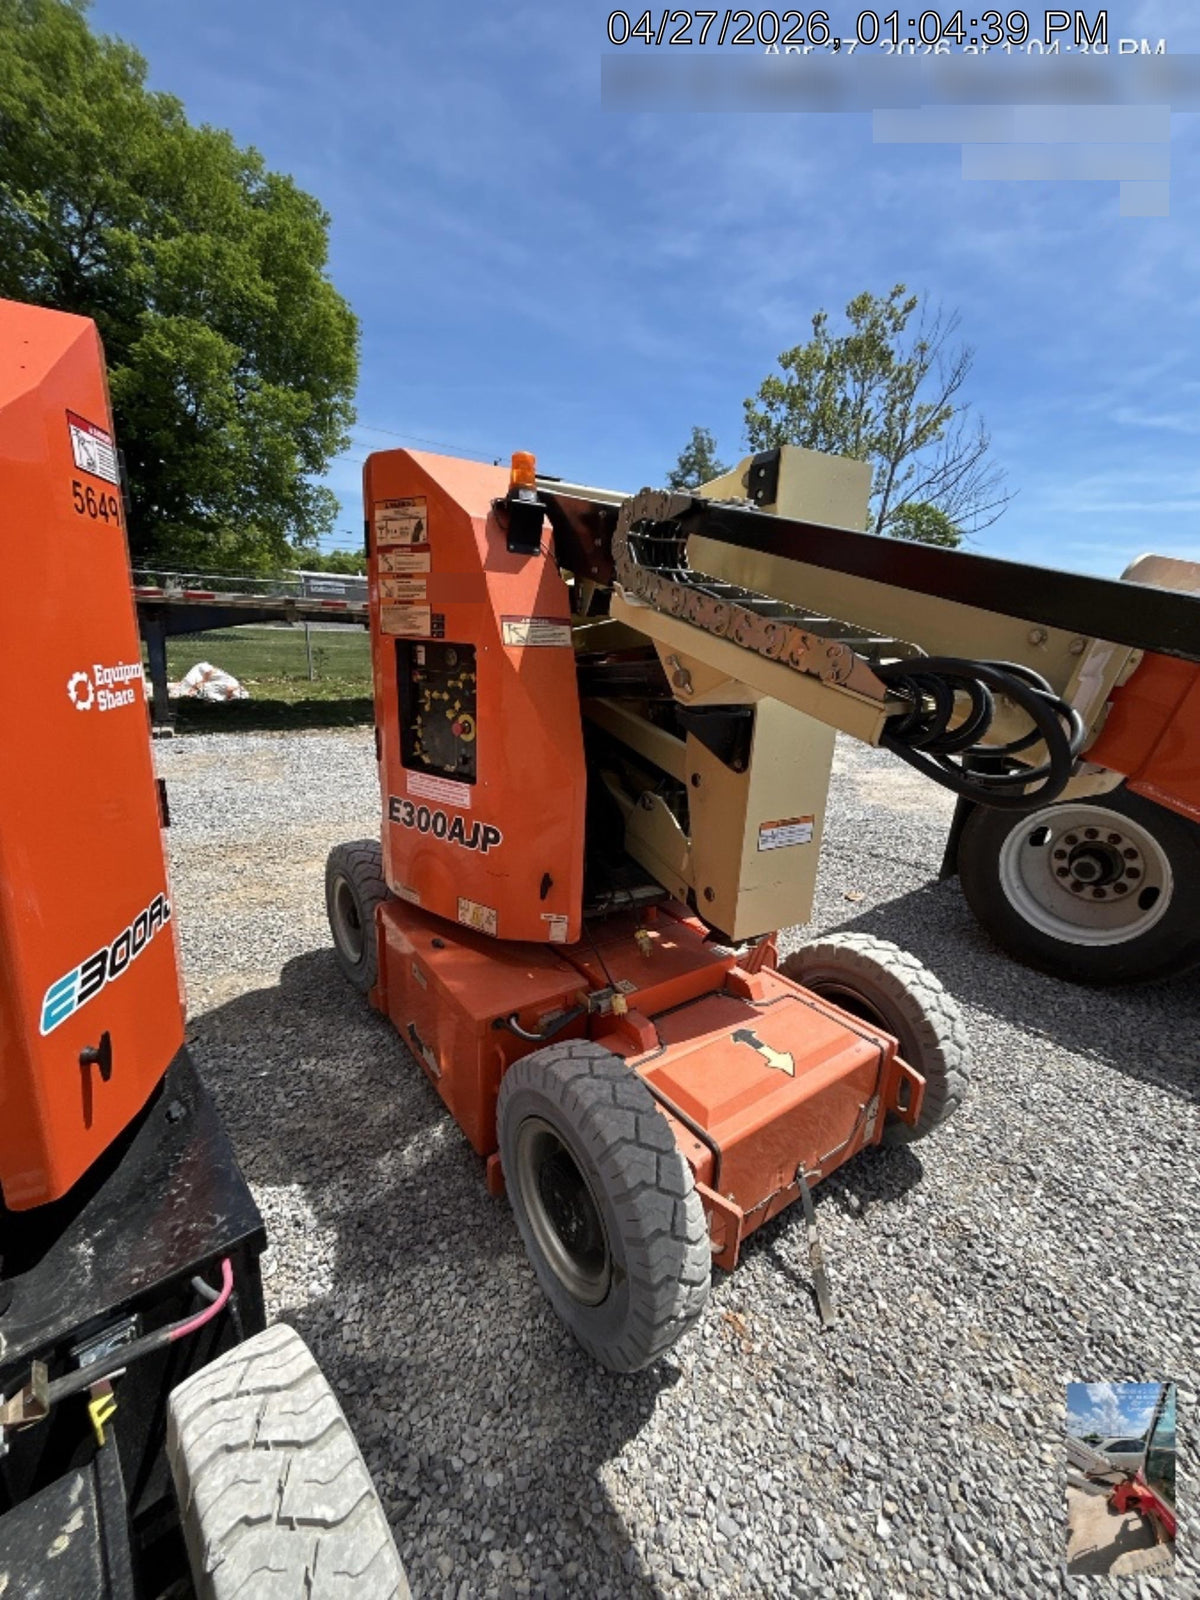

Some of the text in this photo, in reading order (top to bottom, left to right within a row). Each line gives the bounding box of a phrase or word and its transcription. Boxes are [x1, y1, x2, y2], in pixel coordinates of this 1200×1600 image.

[72, 480, 120, 527] 5649
[97, 688, 135, 711] Share
[388, 796, 501, 853] E300AJP
